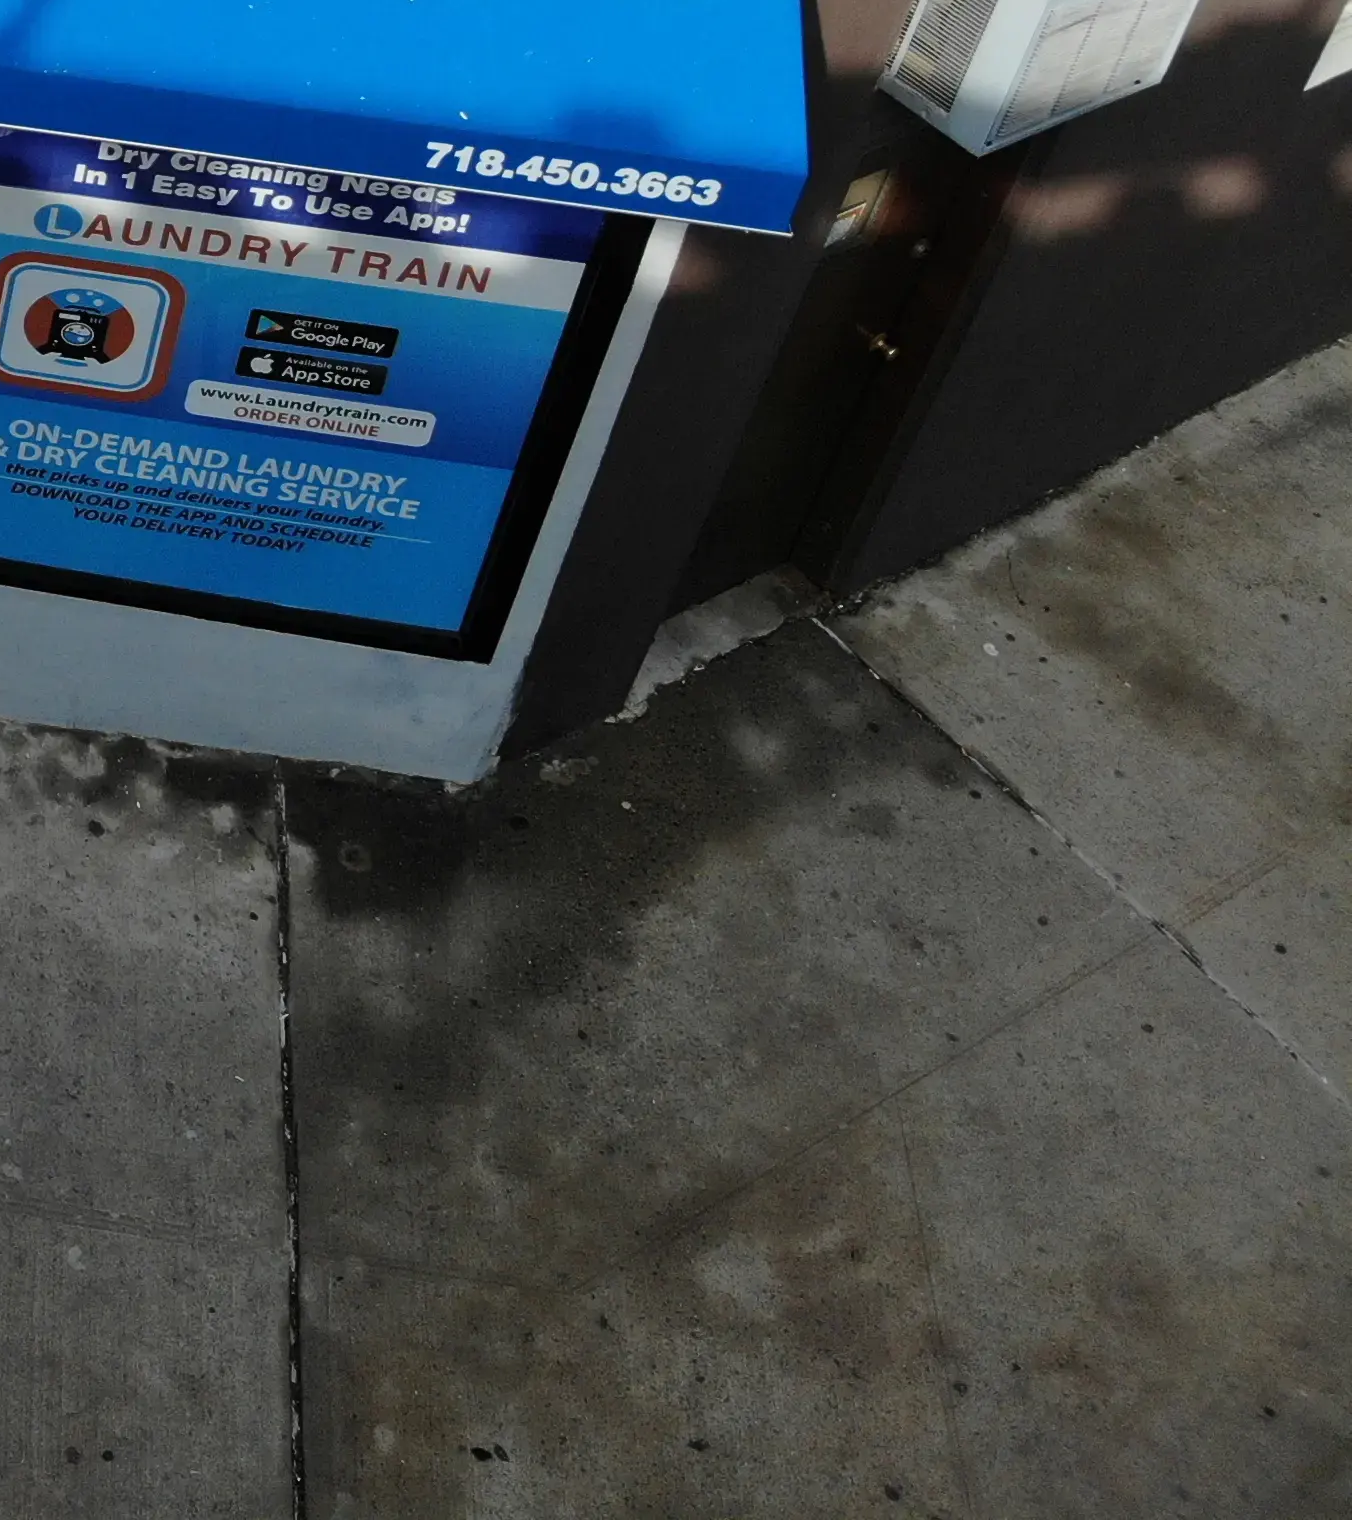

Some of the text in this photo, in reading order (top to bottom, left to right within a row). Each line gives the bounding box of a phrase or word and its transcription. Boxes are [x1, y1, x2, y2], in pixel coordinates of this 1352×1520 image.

[72, 163, 469, 236] In 1 Easy To Use App!
[96, 140, 456, 206] Dry Cleaning Needs
[425, 140, 722, 207] 718.450.3663
[38, 204, 492, 294] LAUNDRY TRAIN
[285, 356, 368, 375] Available on the
[291, 328, 386, 354] Google Play
[200, 387, 428, 428] www.Laundrytrain.com
[281, 366, 371, 389] App Store
[233, 406, 380, 438] ORDER ONLINE
[8, 419, 407, 495] ON-DEMAND LAUNDRY
[18, 441, 89, 469] DRY
[95, 454, 269, 498] CLEANING
[277, 482, 421, 521] SERVICE
[5, 463, 46, 479] that
[47, 468, 100, 487] picks
[105, 478, 129, 493] up
[134, 481, 170, 498] and
[175, 487, 253, 511] delivers
[257, 500, 301, 519] your
[11, 482, 374, 549] DOWNLOAD THE APP AND SCHEDULE
[73, 507, 305, 553] YOUR DELIVERY TODAY!
